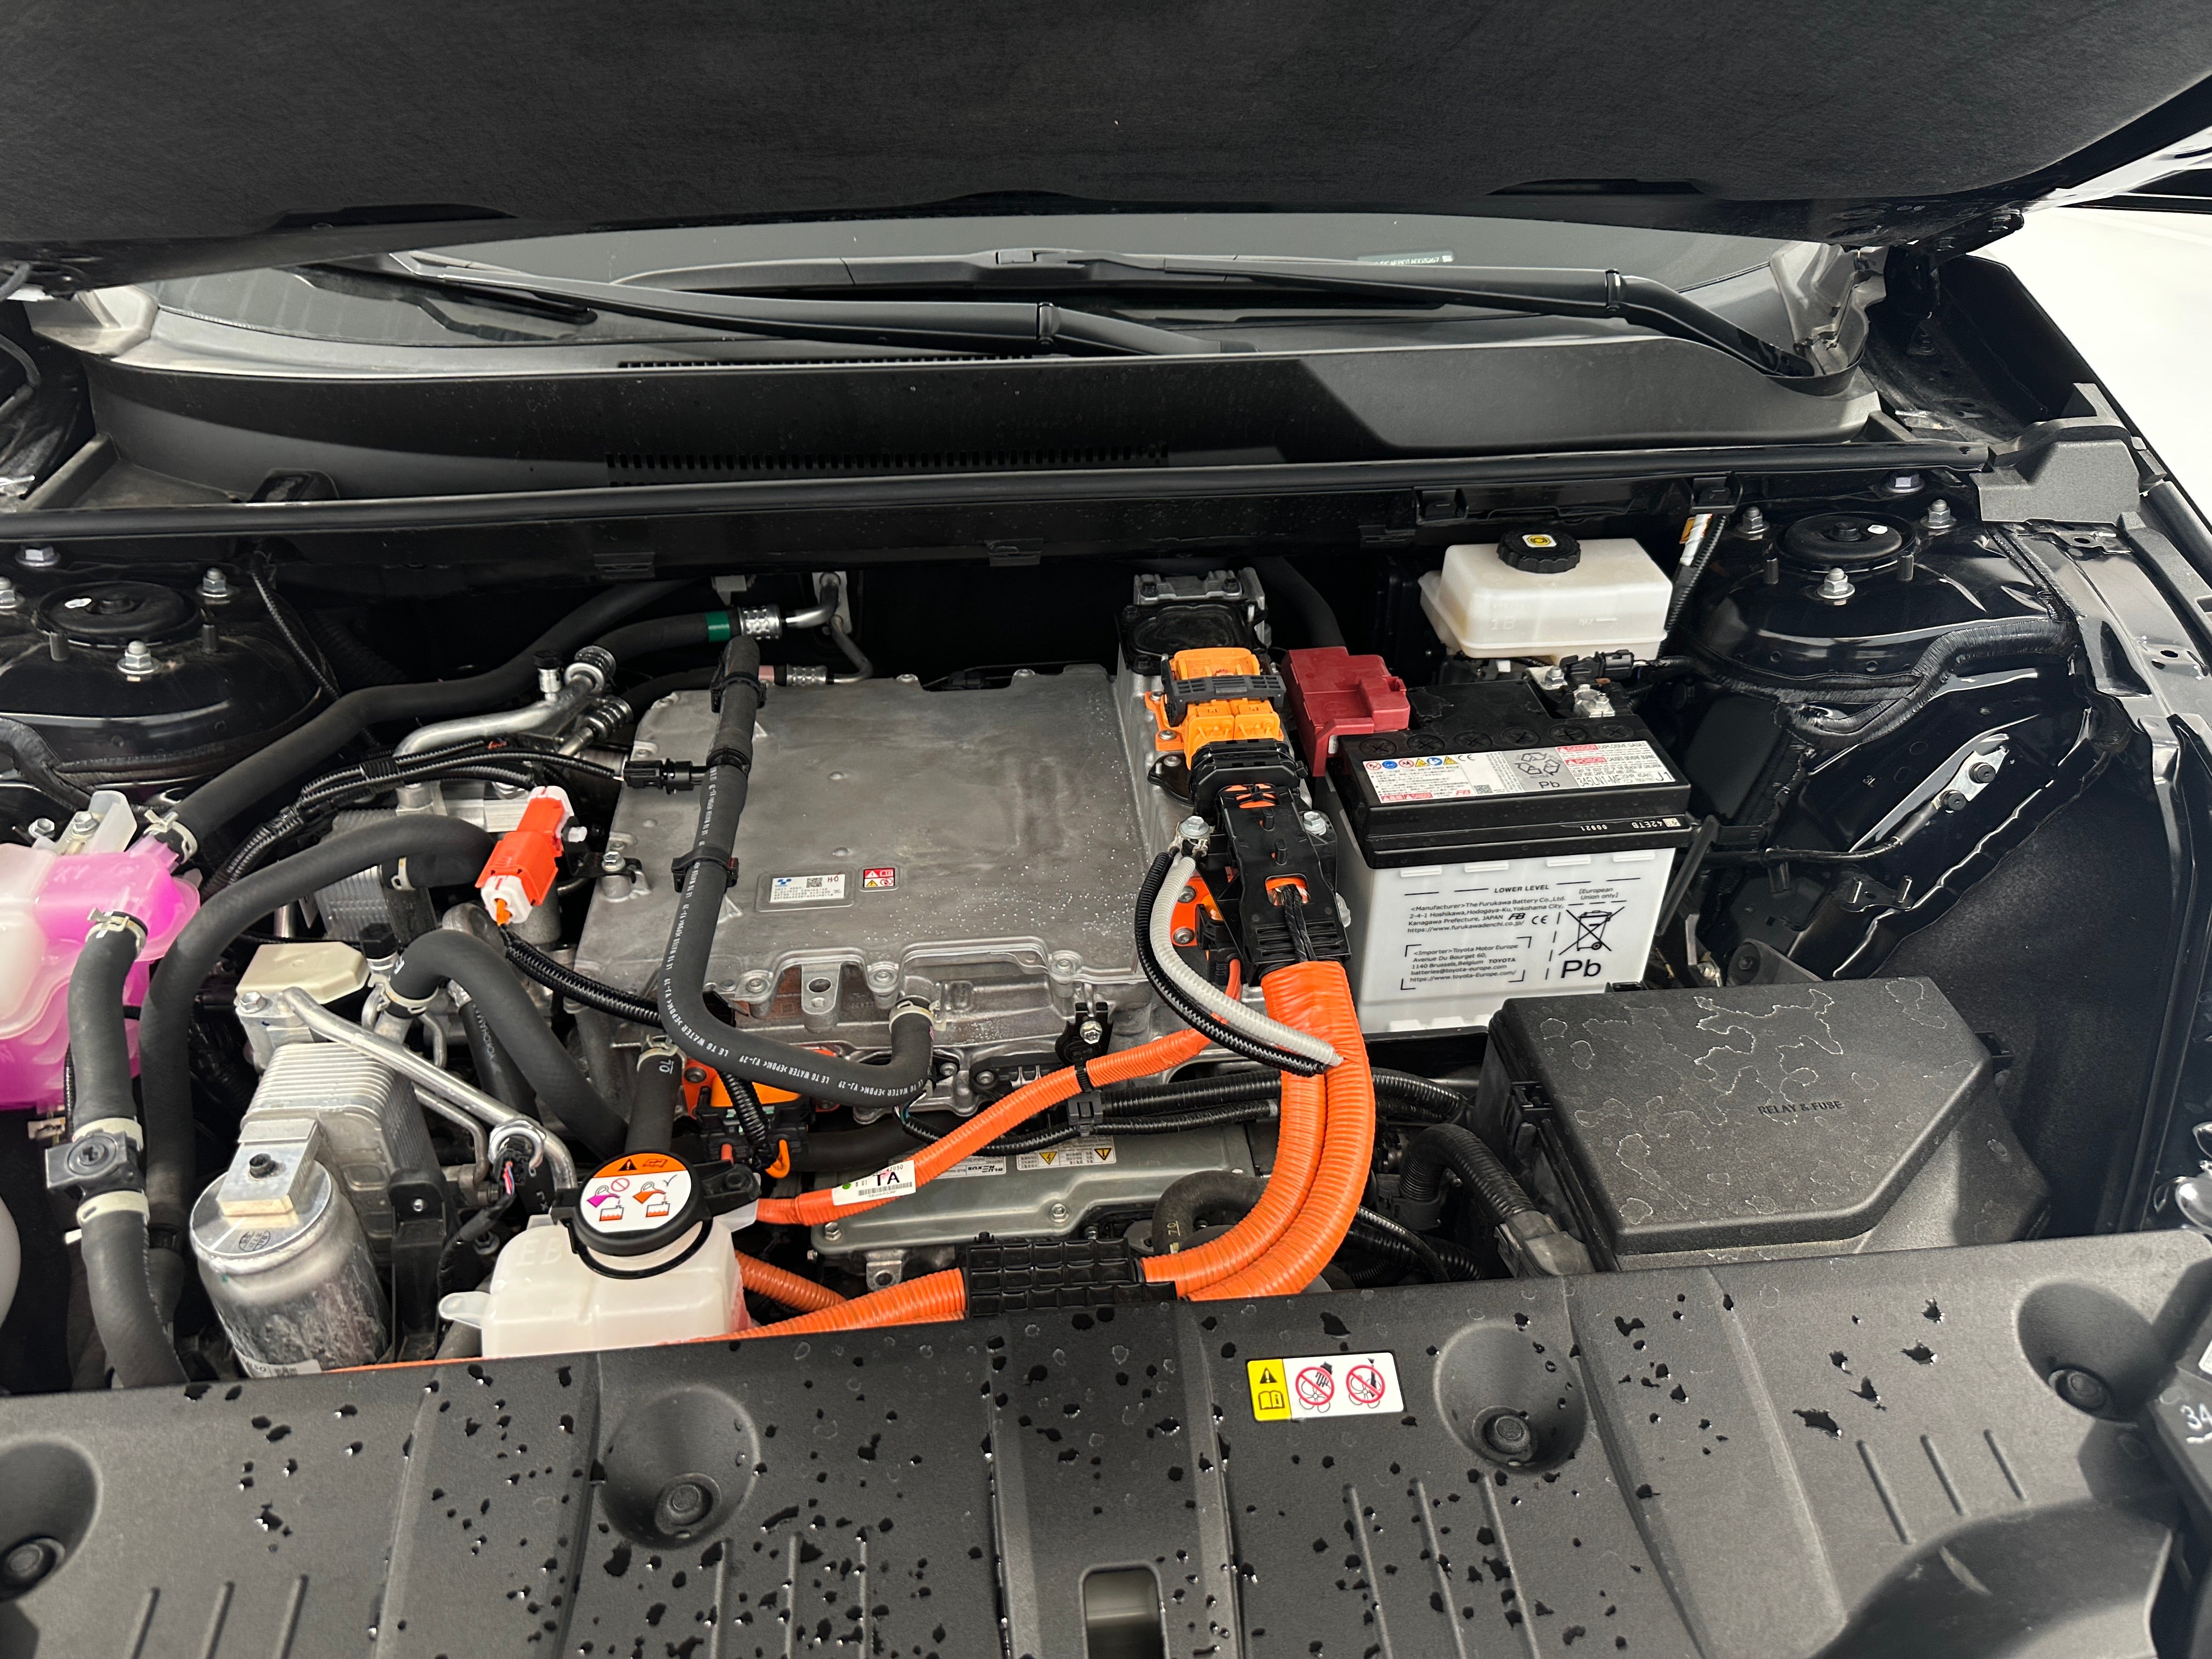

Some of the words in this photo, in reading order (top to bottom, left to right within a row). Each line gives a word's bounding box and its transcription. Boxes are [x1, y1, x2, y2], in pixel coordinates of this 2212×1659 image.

[1577, 775, 1621, 787] 345LN1-MF
[1655, 772, 1673, 781] J1
[1631, 821, 1663, 829] 42ETB
[1479, 899, 1511, 907] Furukawa
[1512, 896, 1538, 906] Battery
[1443, 916, 1480, 924] Prefecture,
[1531, 915, 1548, 925] CE
[1407, 920, 1525, 933] https://www.furukawadenchi.co.jp/
[1449, 953, 1475, 961] Bourget
[1410, 963, 1508, 975] batteries@toyota-europe.com
[1560, 959, 1601, 979] Pb
[1409, 969, 1517, 982] https://www.toyota-Europe.com/
[680, 1024, 705, 1046] WATER
[718, 1047, 729, 1057] LE
[788, 1067, 810, 1079] WATER
[820, 1074, 830, 1084] LE
[887, 1086, 908, 1096] WATER
[1757, 1103, 1797, 1115] RELAY
[1799, 1103, 1810, 1111] &
[1812, 1100, 1843, 1111] FUSE
[874, 1171, 900, 1186] TA
[1167, 1222, 1176, 1235] 70
